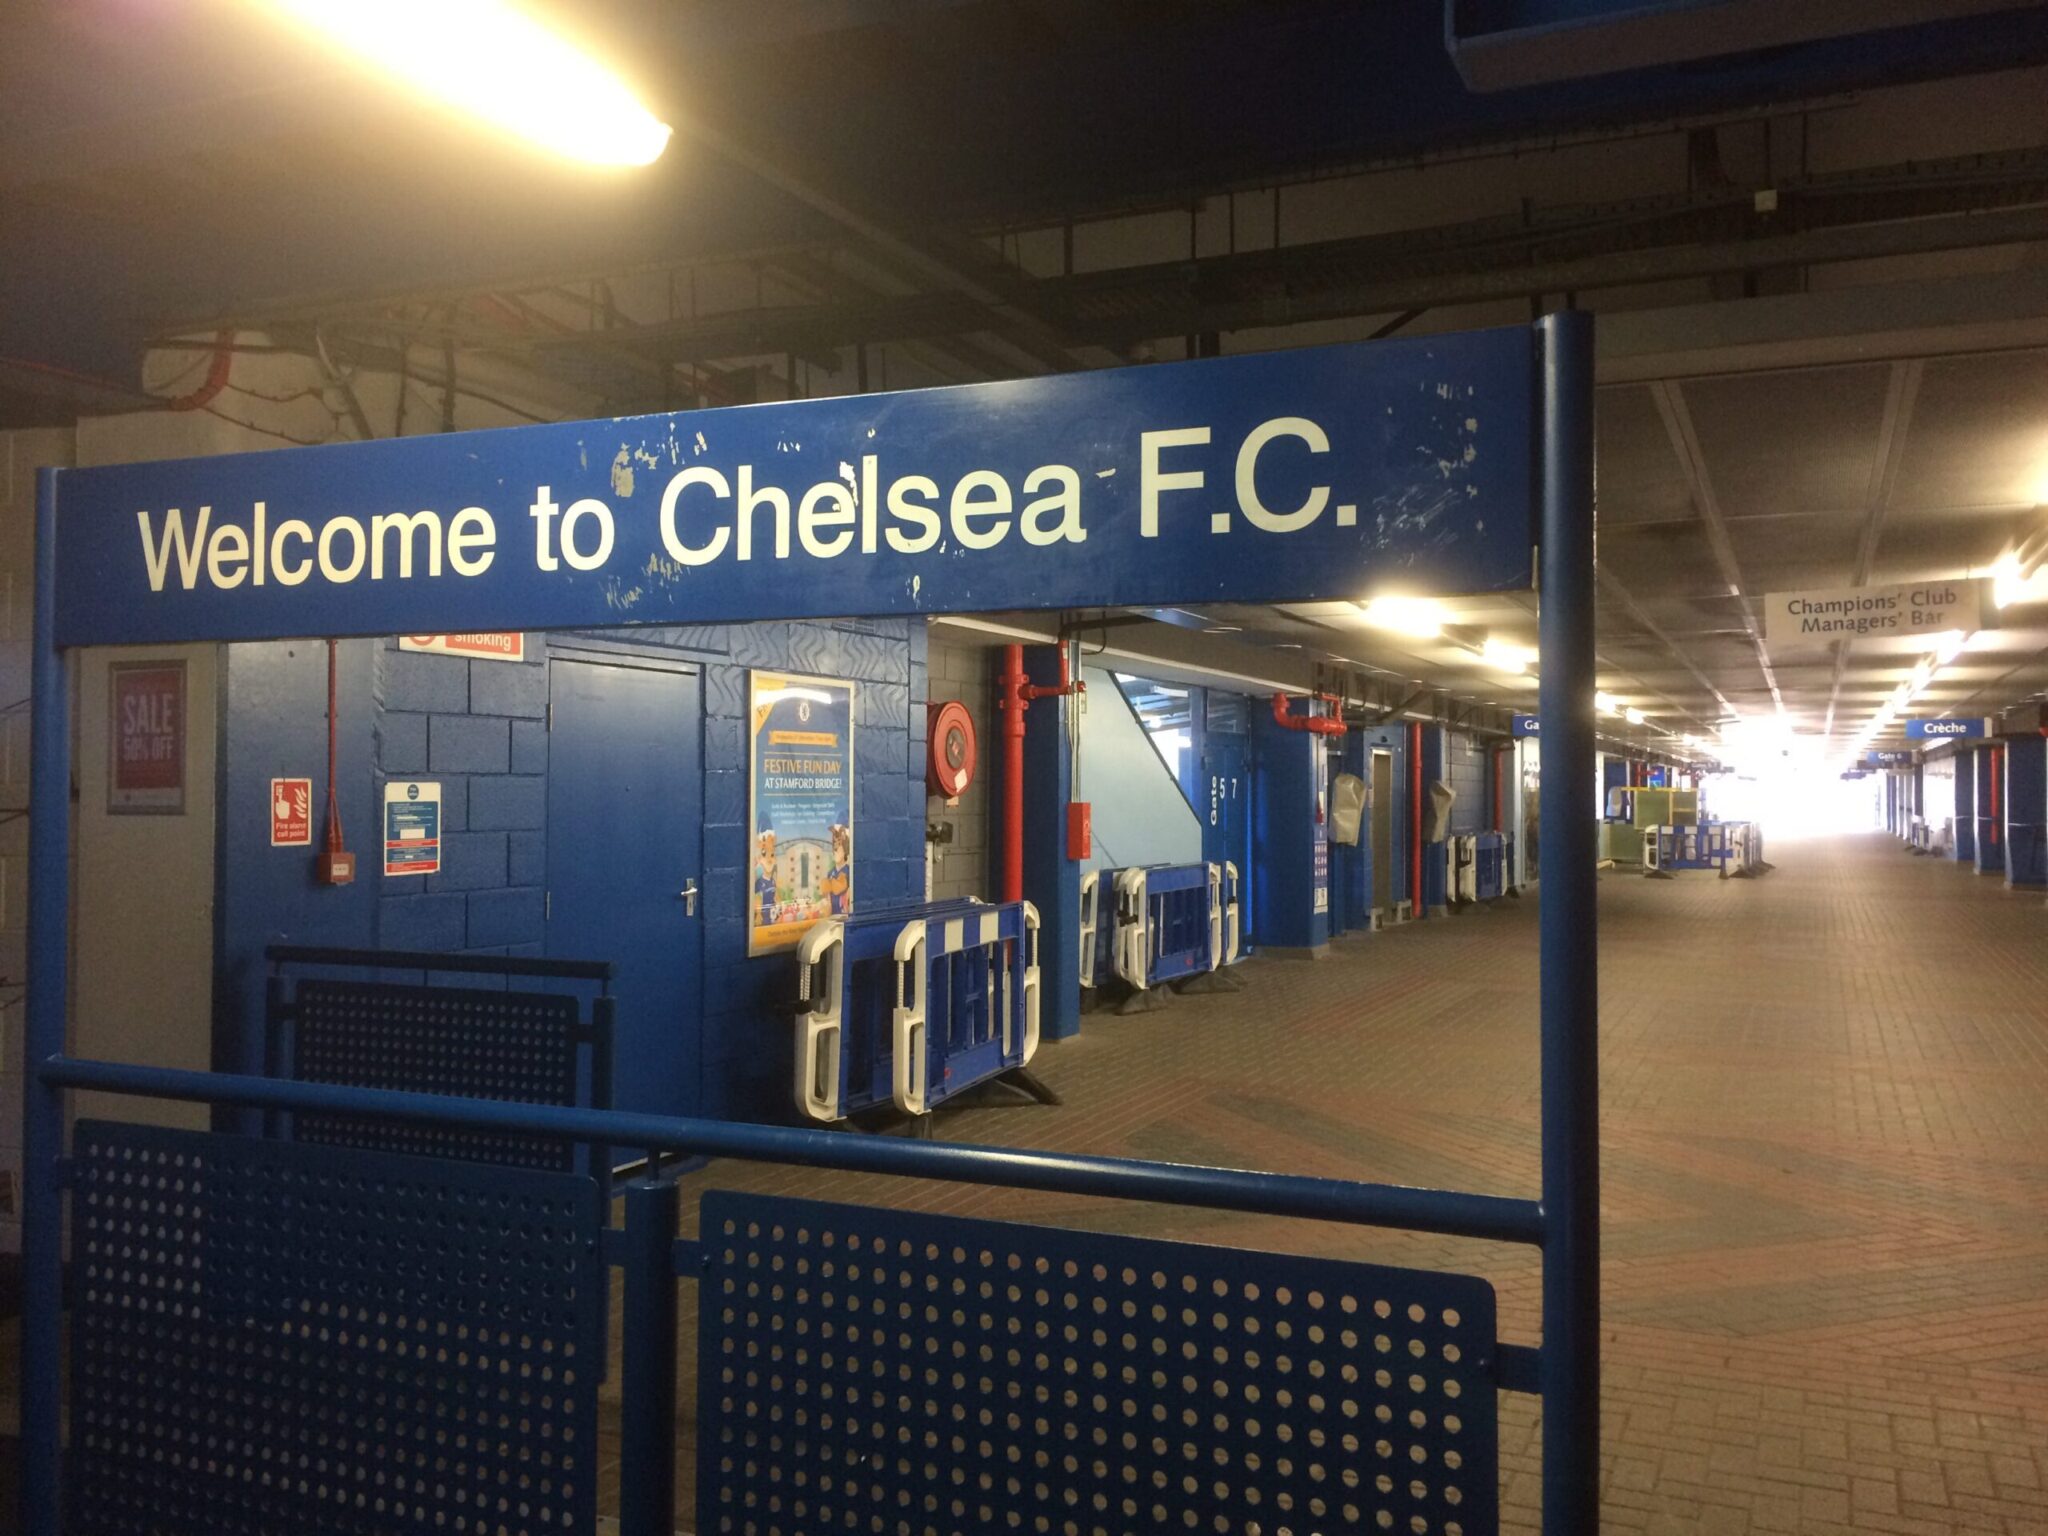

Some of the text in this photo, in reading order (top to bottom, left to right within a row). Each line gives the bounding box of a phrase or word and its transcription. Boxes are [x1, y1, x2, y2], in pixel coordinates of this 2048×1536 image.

[137, 416, 1357, 592] Welcome to Chelsea F.C.
[1911, 588, 1957, 607] Club
[1911, 610, 1945, 626] Bar
[123, 693, 174, 735] SALE
[1524, 719, 1540, 731] Ga
[1923, 722, 1967, 734] Crèche
[151, 735, 174, 761] OFF
[764, 759, 842, 775] FESTIVE FUN DAY
[764, 777, 774, 789] AT
[774, 777, 814, 789] STAMFORD
[275, 822, 289, 830] Fire
[276, 830, 306, 839] call point
